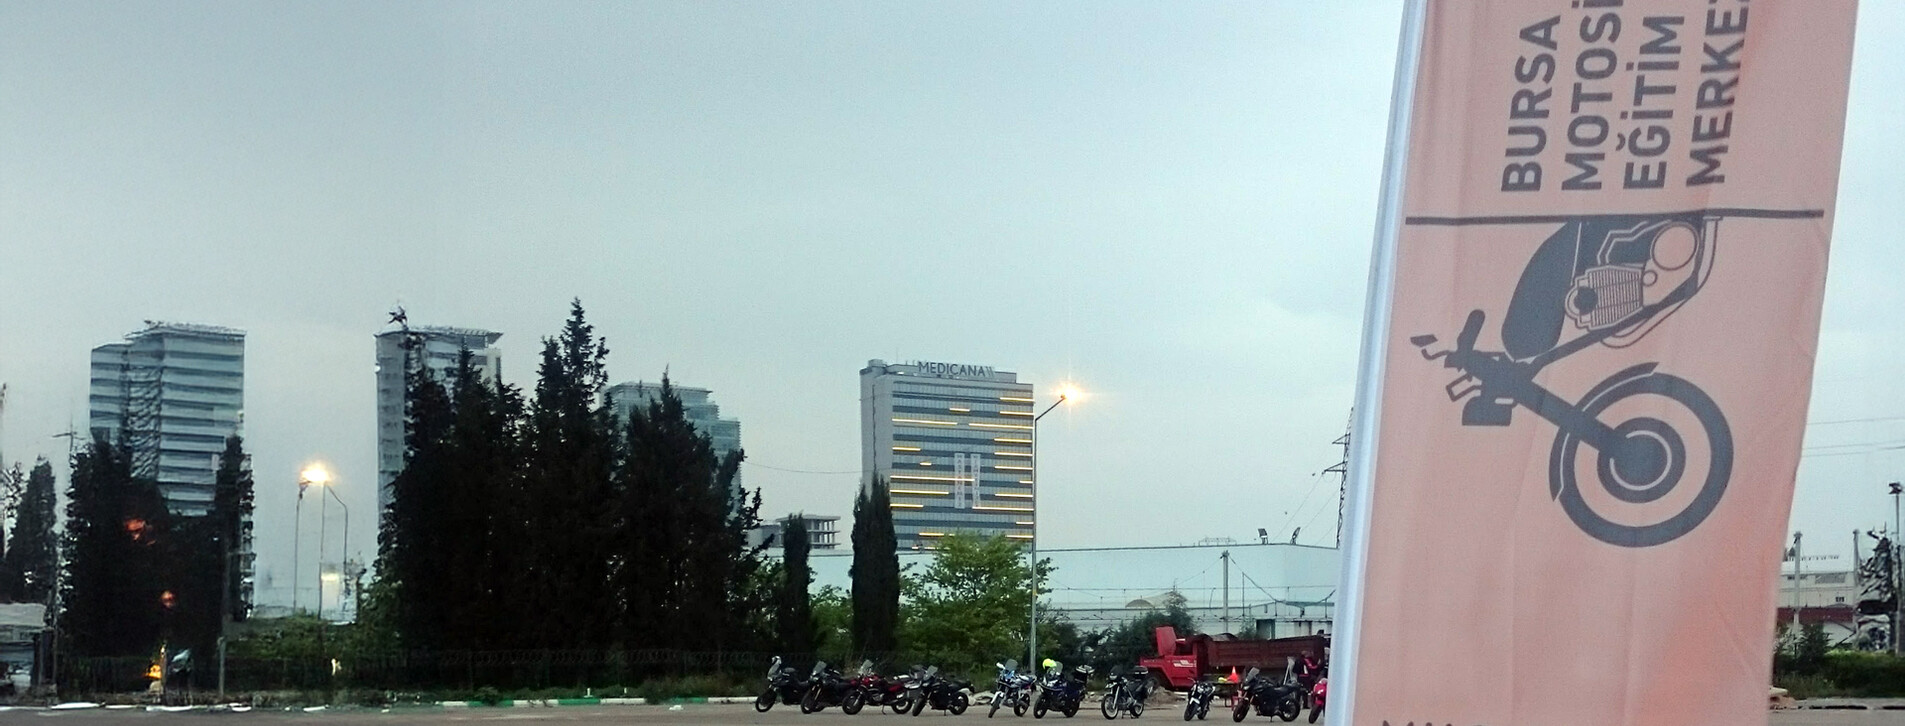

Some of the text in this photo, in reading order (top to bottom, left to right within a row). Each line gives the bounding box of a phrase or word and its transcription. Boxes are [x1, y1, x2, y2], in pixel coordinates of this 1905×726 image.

[1501, 15, 1561, 192] BURSA
[1615, 16, 1684, 189] EĞİTİM
[1686, 0, 1749, 187] MERKE
[918, 361, 986, 377] MEDICANA
